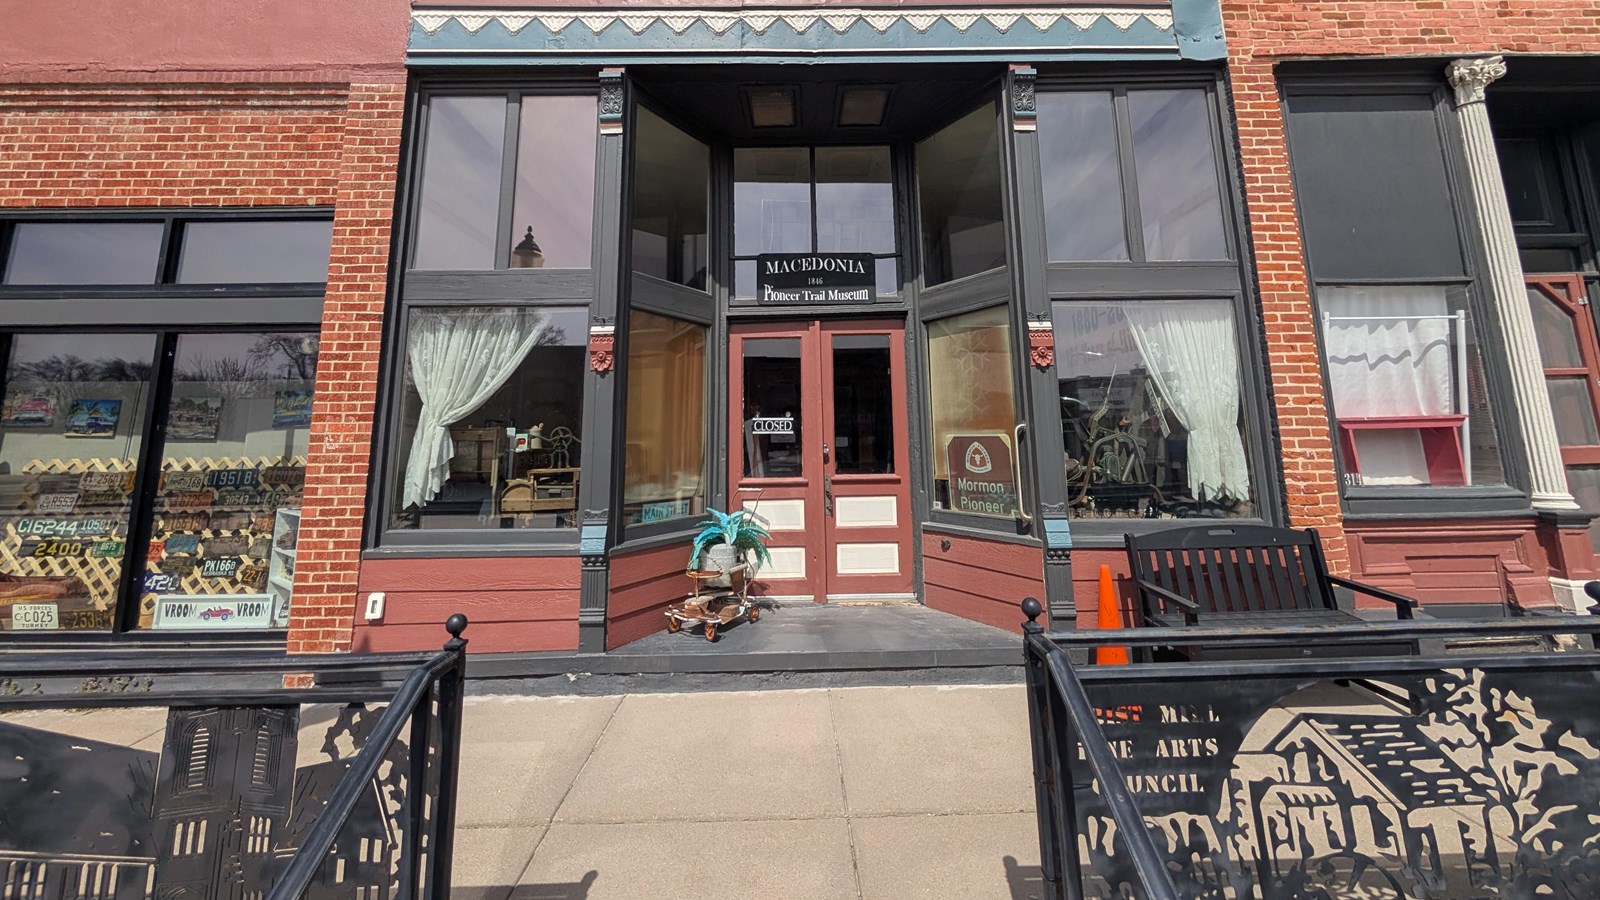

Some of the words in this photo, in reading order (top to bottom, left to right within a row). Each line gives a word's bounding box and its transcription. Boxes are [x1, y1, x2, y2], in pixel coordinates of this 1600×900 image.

[765, 257, 866, 275] MACEDONIA
[807, 277, 824, 285] 1846
[763, 284, 801, 301] Pioneer
[802, 289, 826, 301] Trail
[828, 288, 869, 301] Museum
[753, 420, 793, 432] CLOSED
[213, 472, 251, 486] 19518
[957, 477, 1004, 494] Mormon
[1344, 472, 1363, 487] 314
[960, 496, 1005, 514] Pioneer
[644, 506, 664, 520] MAIN
[18, 519, 78, 535] C16244
[80, 519, 111, 530] 10581
[34, 542, 82, 556] 2400
[165, 602, 197, 618] VROOM
[237, 602, 270, 617] VROOM
[1155, 737, 1219, 758] ARTS
[1092, 773, 1205, 795] CUNCIL
